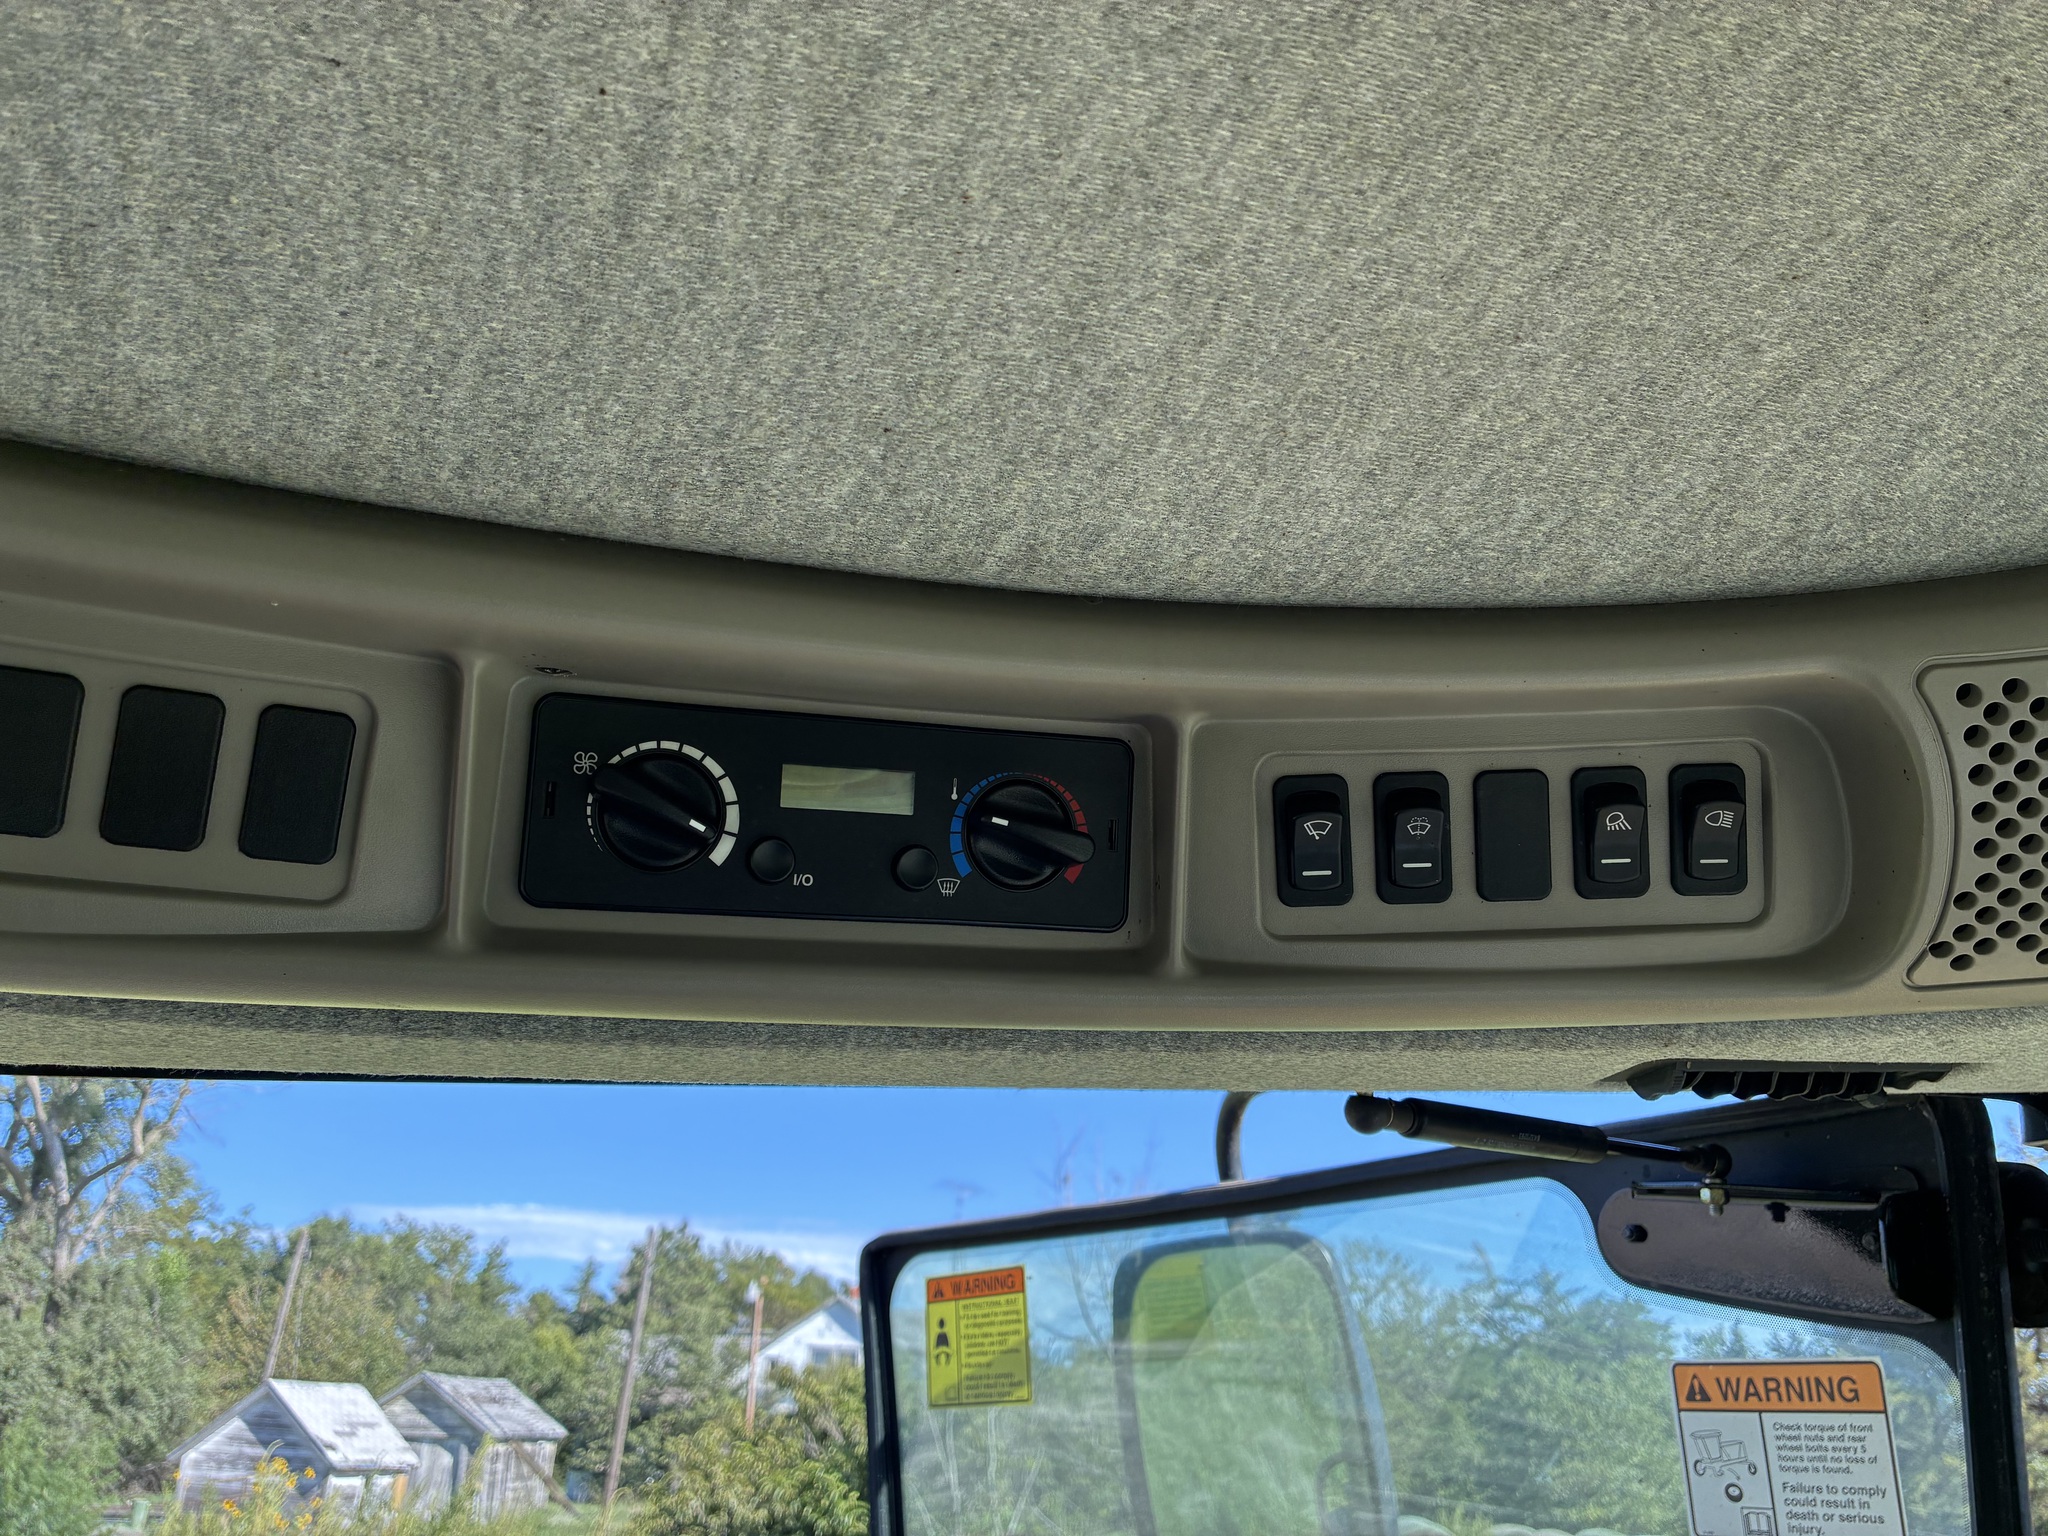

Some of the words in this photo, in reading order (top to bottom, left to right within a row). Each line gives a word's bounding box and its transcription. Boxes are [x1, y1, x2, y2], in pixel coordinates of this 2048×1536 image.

[793, 874, 814, 887] I/O
[950, 1273, 1015, 1295] WARNING
[1716, 1376, 1859, 1402] WARNING
[1772, 1421, 1803, 1432] Check
[1804, 1422, 1836, 1433] torque
[1837, 1422, 1848, 1432] of
[1849, 1423, 1873, 1433] front
[1774, 1433, 1802, 1442] wheel
[1803, 1433, 1825, 1442] nuts
[1827, 1433, 1845, 1443] and
[1847, 1435, 1867, 1443] rear
[1775, 1443, 1803, 1452] wheel
[1804, 1443, 1829, 1453] bolts
[1831, 1445, 1858, 1455] every
[1860, 1444, 1867, 1453] 5
[1777, 1453, 1805, 1463] hours
[1806, 1453, 1828, 1463] until
[1830, 1455, 1843, 1464] no
[1845, 1455, 1866, 1464] loss
[1867, 1455, 1878, 1464] of
[1778, 1464, 1810, 1475] torque
[1811, 1464, 1821, 1474] is
[1822, 1464, 1854, 1475] found.
[1781, 1481, 1824, 1494] Failure
[1825, 1483, 1838, 1495] to
[1841, 1484, 1887, 1499] comply
[1783, 1496, 1817, 1507] could
[1820, 1497, 1856, 1509] result
[1858, 1497, 1871, 1509] in
[1785, 1508, 1819, 1521] death
[1822, 1512, 1835, 1522] or
[1838, 1511, 1885, 1524] serious
[1786, 1521, 1826, 1536] injury.
